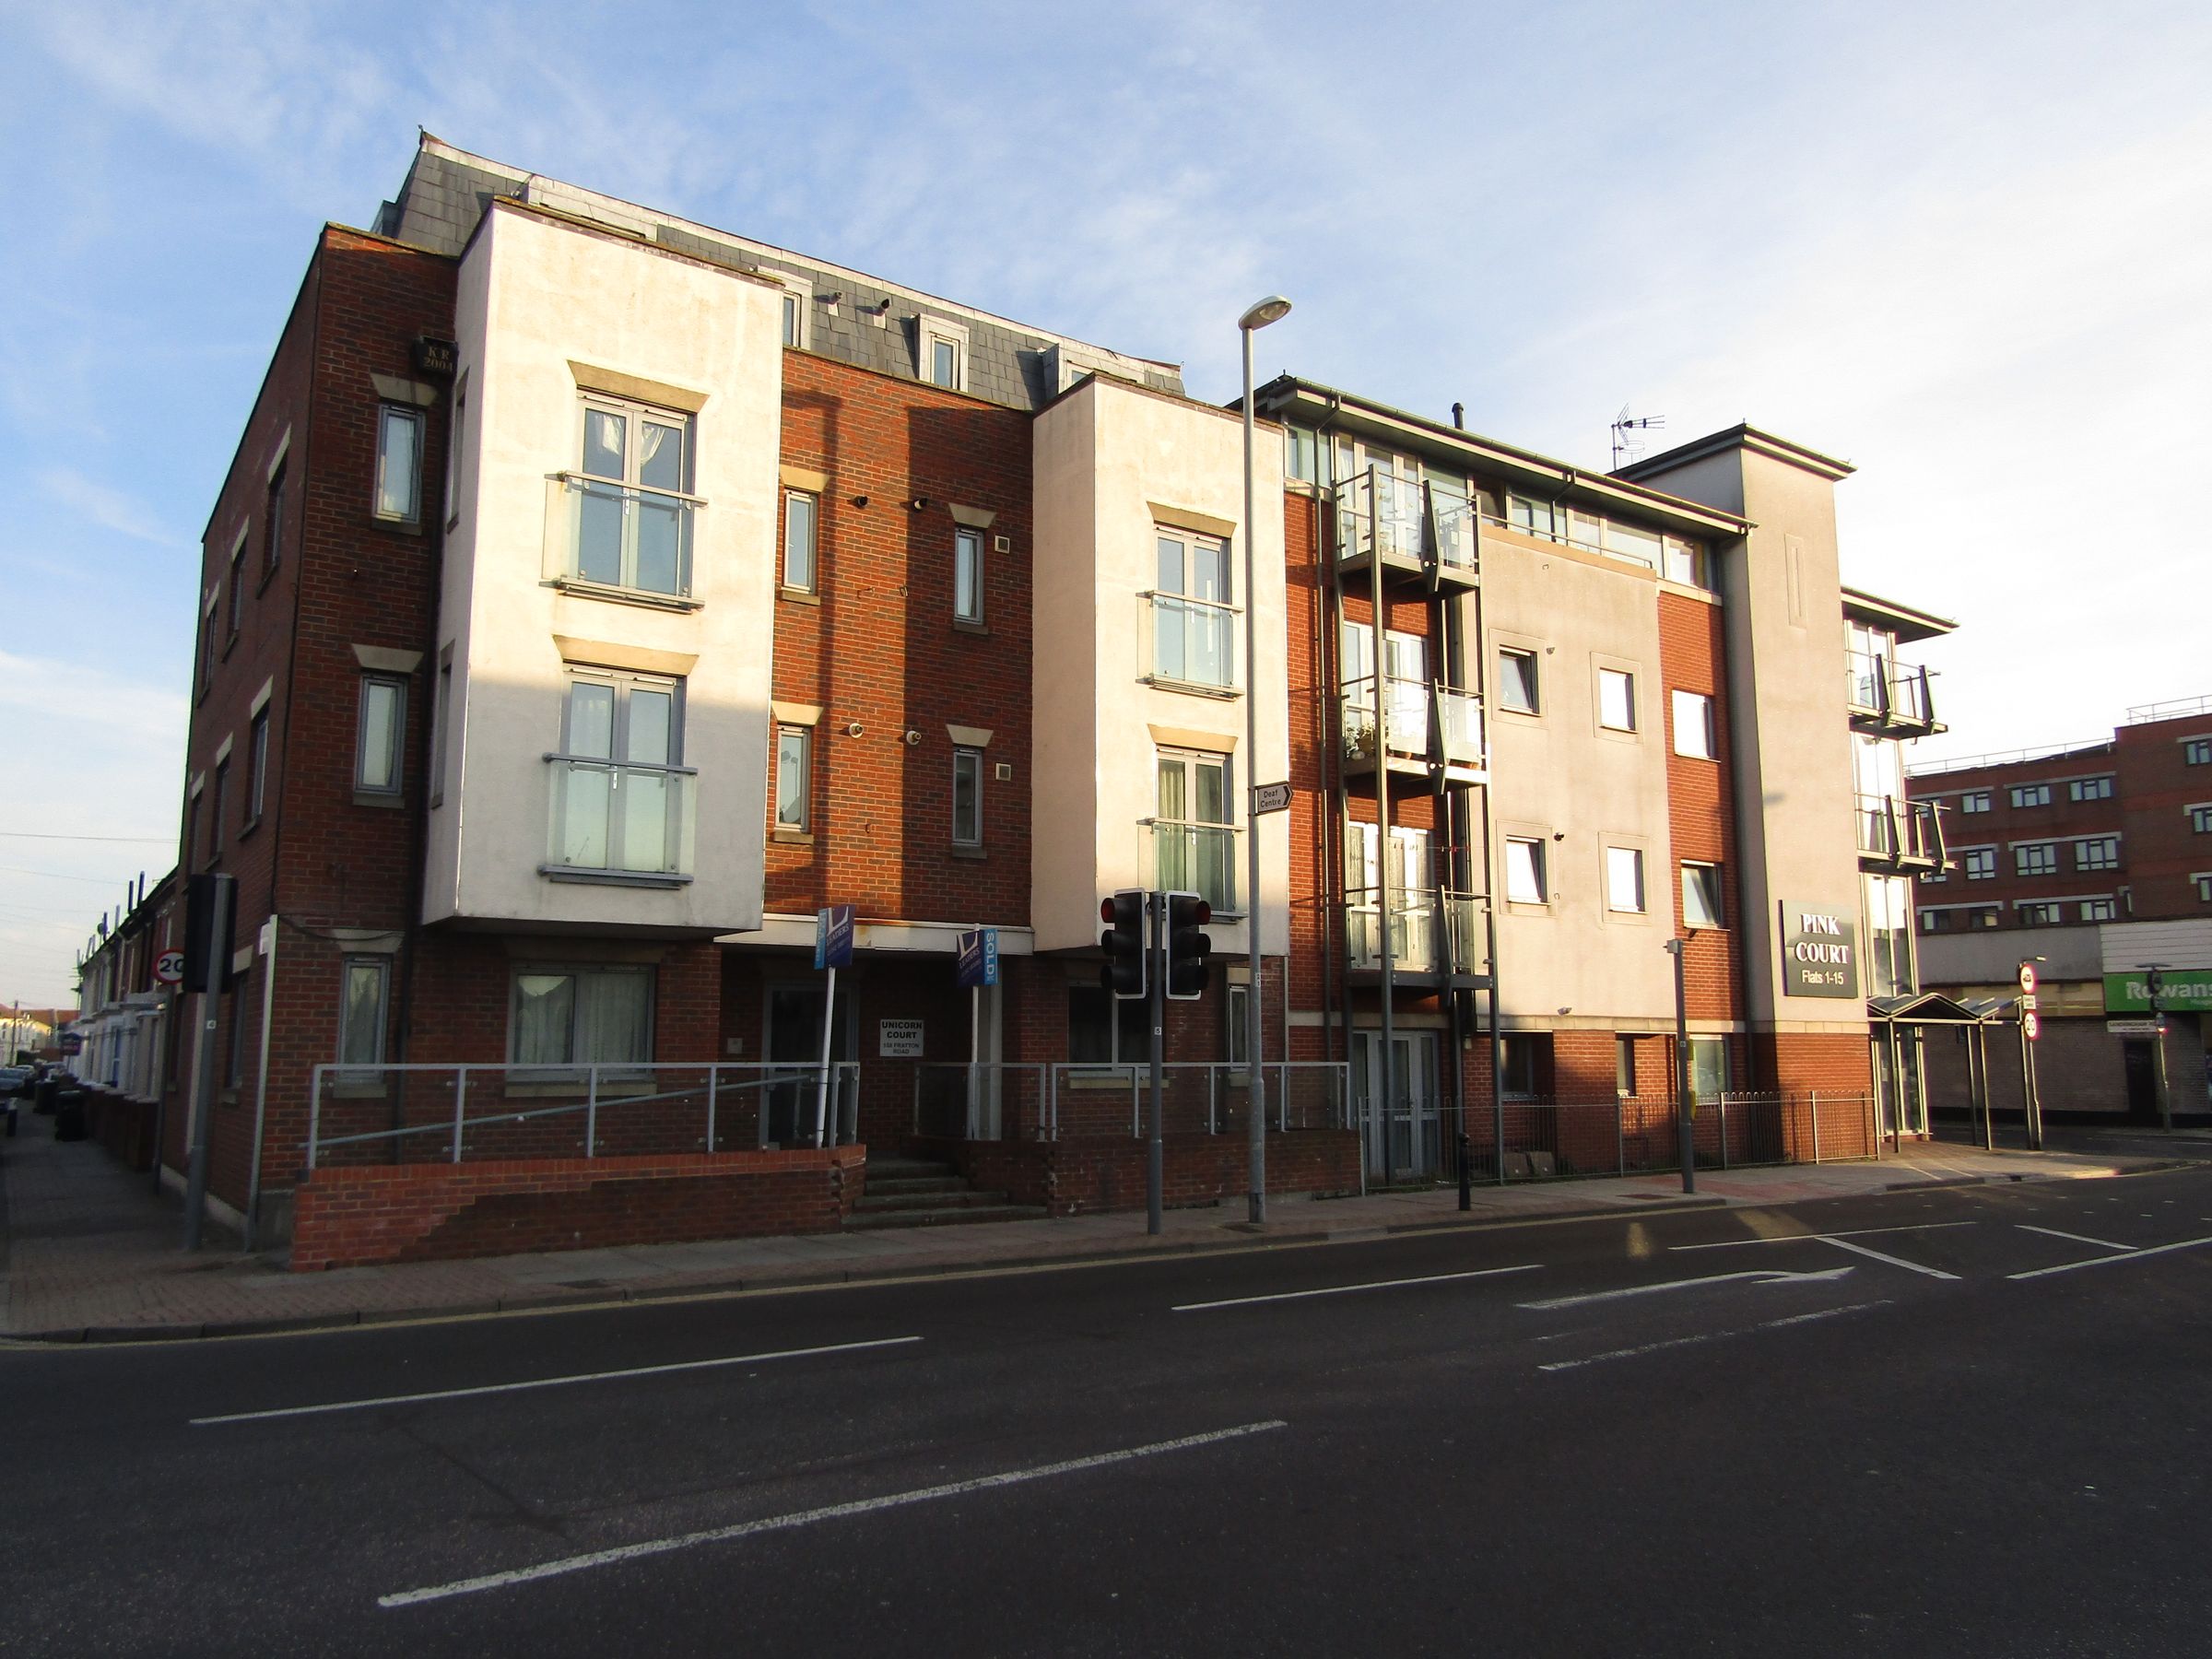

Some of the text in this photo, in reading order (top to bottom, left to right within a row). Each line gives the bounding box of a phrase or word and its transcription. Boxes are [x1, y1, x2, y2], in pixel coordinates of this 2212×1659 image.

[1260, 799, 1281, 807] Centre
[1264, 790, 1277, 798] Deaf
[1801, 913, 1841, 935] PINK
[827, 923, 849, 947] LEADERS
[959, 947, 981, 969] LEADERS
[986, 932, 995, 975] SOLD
[1794, 941, 1849, 964] COURT
[159, 959, 183, 972] 20
[1802, 970, 1844, 985] Flats 1-15
[882, 1020, 923, 1029] UNICORN
